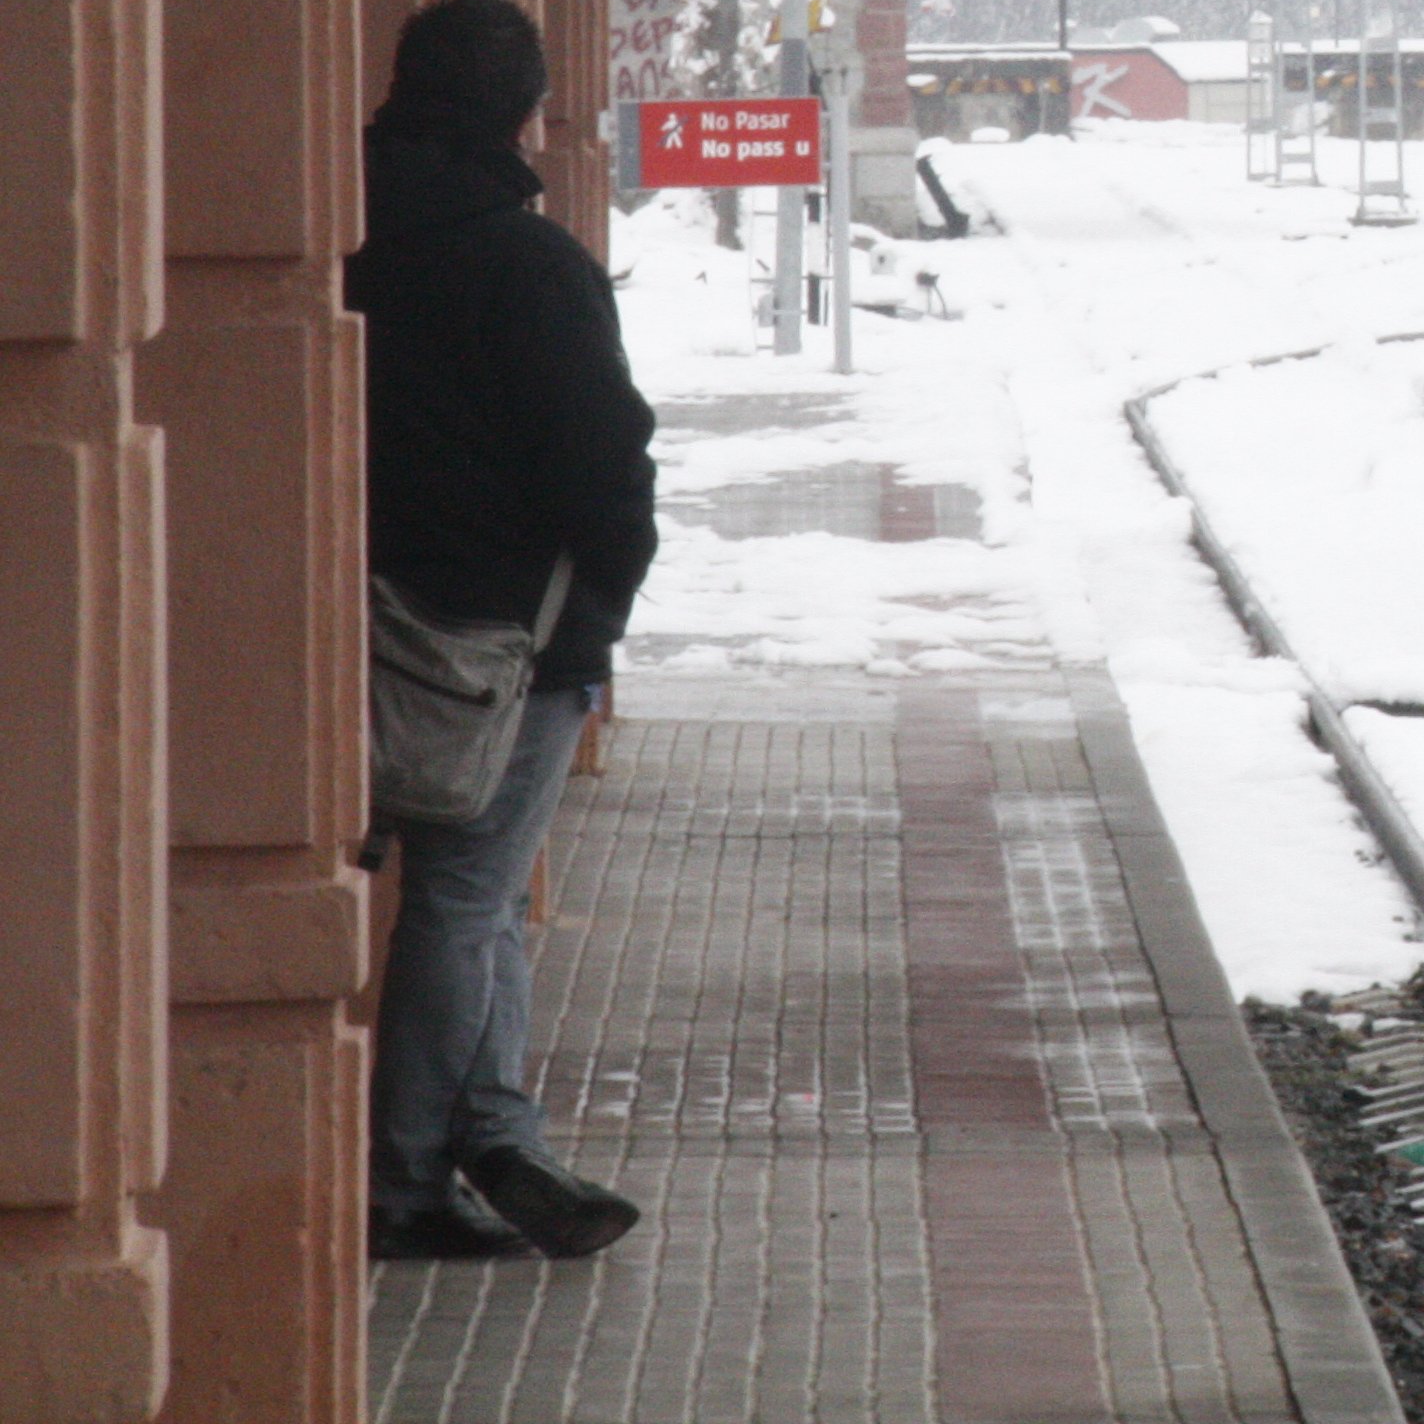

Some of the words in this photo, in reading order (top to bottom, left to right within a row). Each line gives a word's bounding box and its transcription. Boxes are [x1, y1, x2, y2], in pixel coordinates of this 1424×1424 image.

[701, 111, 729, 131] No
[735, 110, 791, 131] Pasar
[701, 139, 731, 159] No
